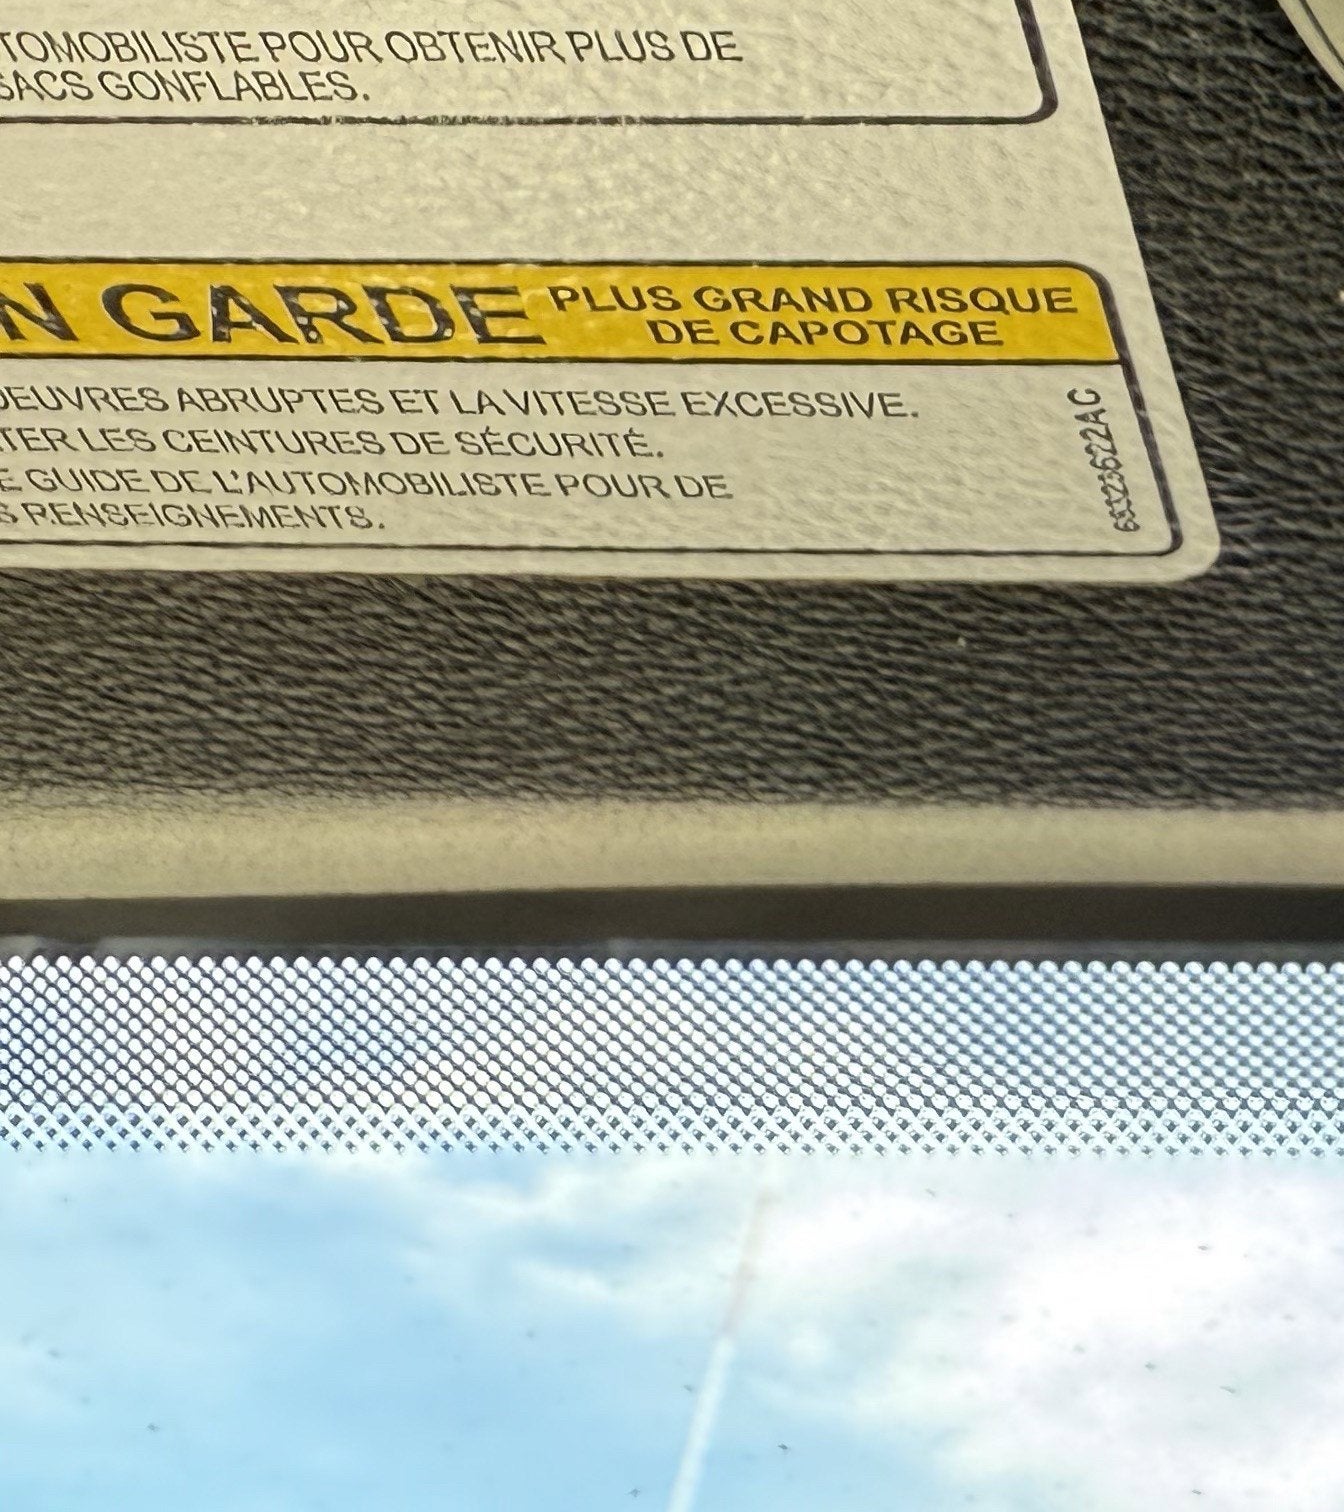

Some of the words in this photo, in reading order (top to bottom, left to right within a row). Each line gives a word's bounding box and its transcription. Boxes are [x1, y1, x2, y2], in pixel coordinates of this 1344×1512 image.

[0, 30, 260, 64] TOMOBILISTE
[258, 30, 384, 64] POUR
[384, 30, 567, 64] OBTENIR
[564, 30, 676, 63] PLUS
[678, 30, 744, 62] DE
[97, 70, 371, 103] GONFLABLES.
[0, 282, 79, 343] N
[101, 282, 548, 346] GARDE
[547, 285, 682, 313] PLUS
[693, 285, 875, 315] GRAND
[884, 286, 1079, 316] RISQUE
[646, 319, 721, 345] DE
[729, 319, 1005, 347] CAPOTAGE
[177, 387, 386, 416] ABRUPTES
[387, 388, 441, 416] ET
[448, 388, 507, 417] LA
[502, 390, 677, 417] VITESSE
[679, 390, 920, 419] EXCESSIVE.
[77, 427, 157, 454] LES
[161, 429, 386, 456] CEINTURES
[388, 431, 450, 456] DE
[453, 426, 665, 459] SÉCURITÉ.
[24, 468, 152, 494] GUIDE
[150, 469, 214, 495] DE
[554, 473, 672, 500] POUR
[673, 474, 734, 501] DE
[20, 501, 386, 531] RENSEIGNEMENTS.
